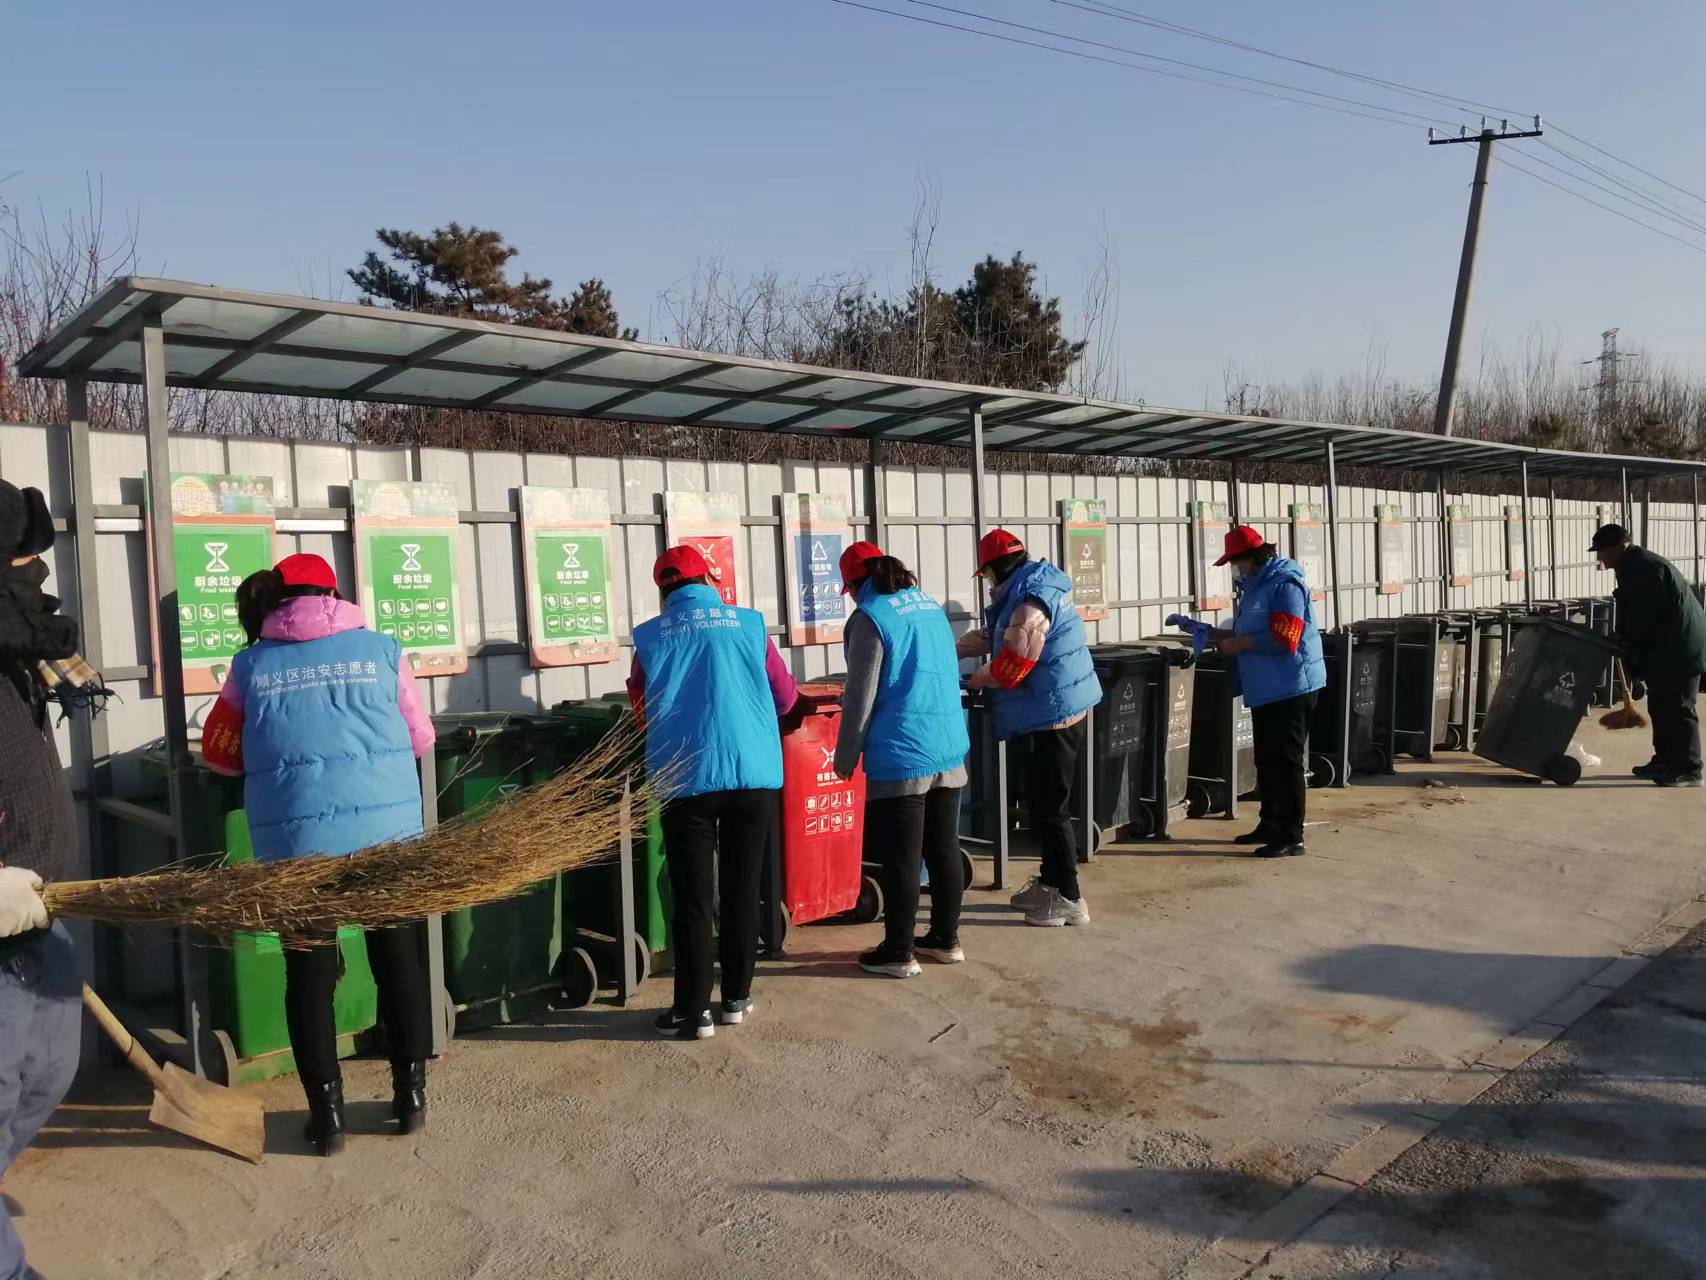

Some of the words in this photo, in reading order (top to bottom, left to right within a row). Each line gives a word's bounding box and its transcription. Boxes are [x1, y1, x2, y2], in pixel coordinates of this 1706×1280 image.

[195, 576, 243, 588] 厨余垃圾
[256, 660, 377, 689] 顺义区治安志愿者
